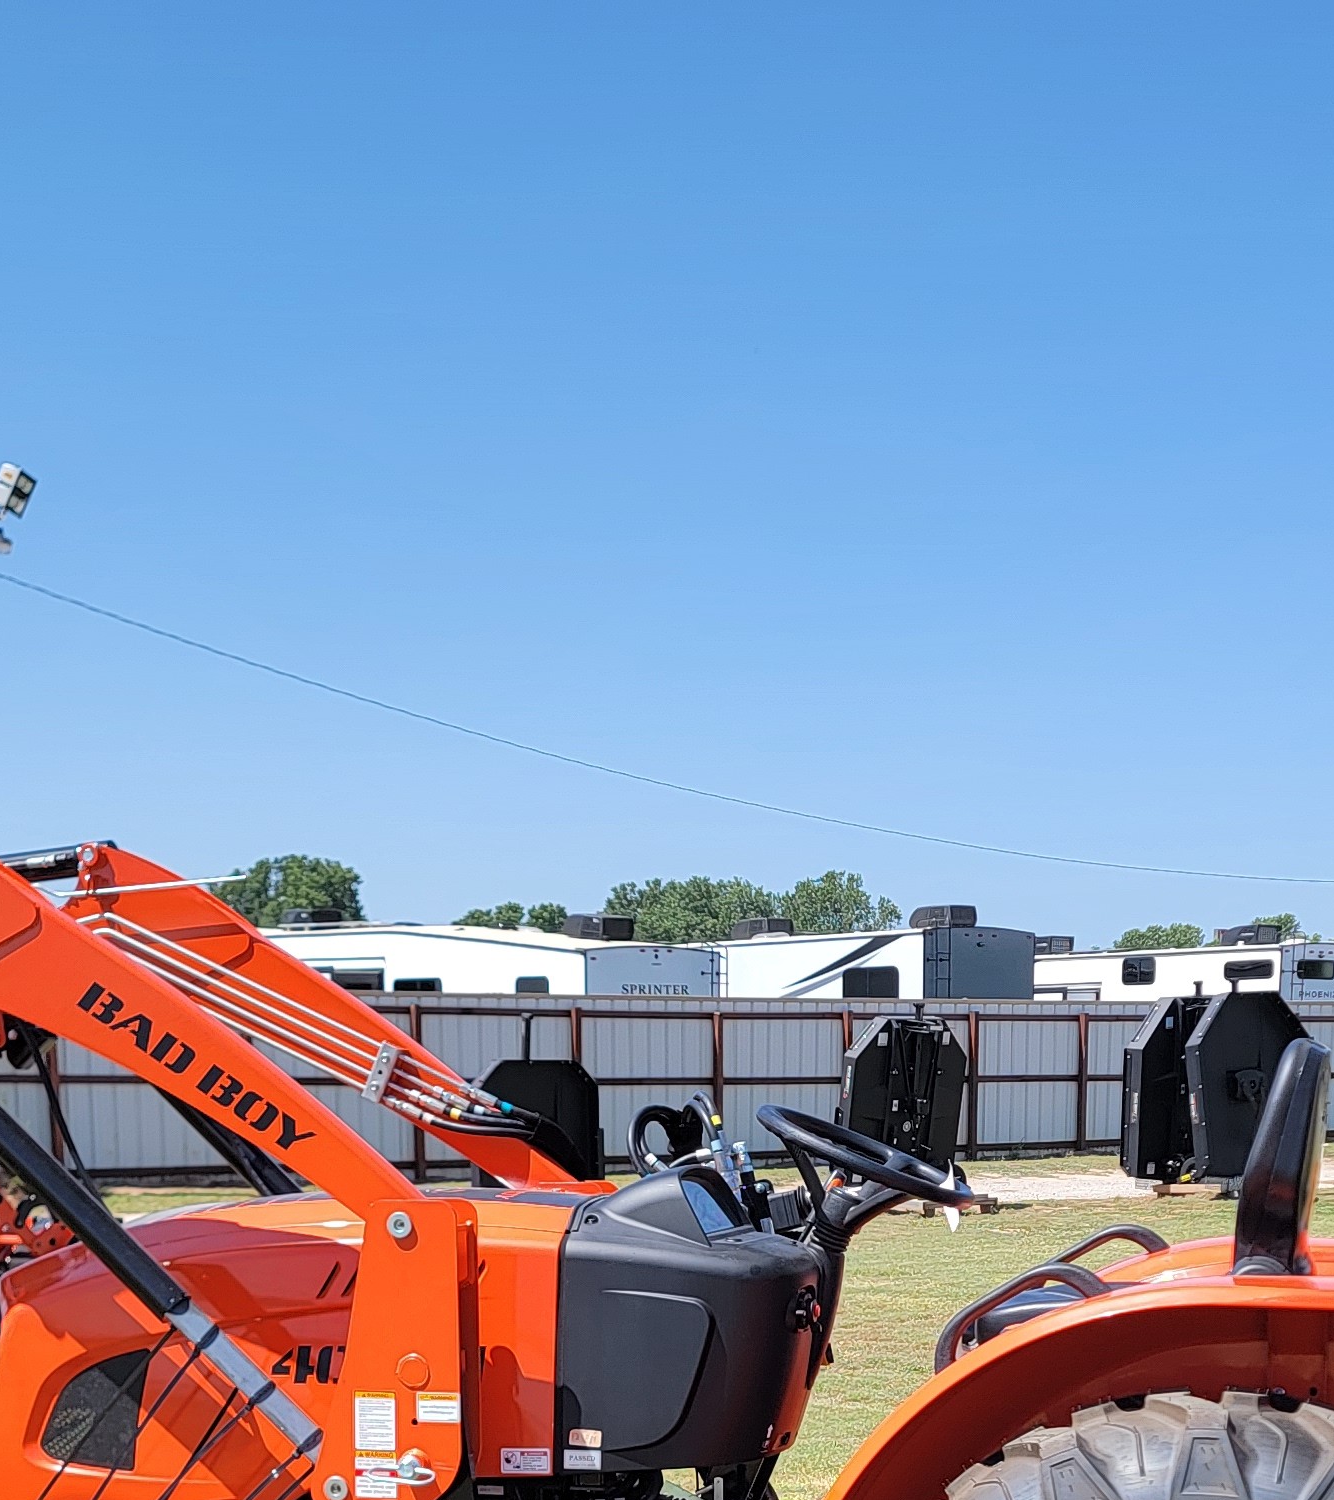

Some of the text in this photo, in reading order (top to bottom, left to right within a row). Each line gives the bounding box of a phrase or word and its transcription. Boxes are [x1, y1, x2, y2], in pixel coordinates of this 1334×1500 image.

[621, 983, 690, 995] SPRINTER
[76, 982, 317, 1150] BAD BOY
